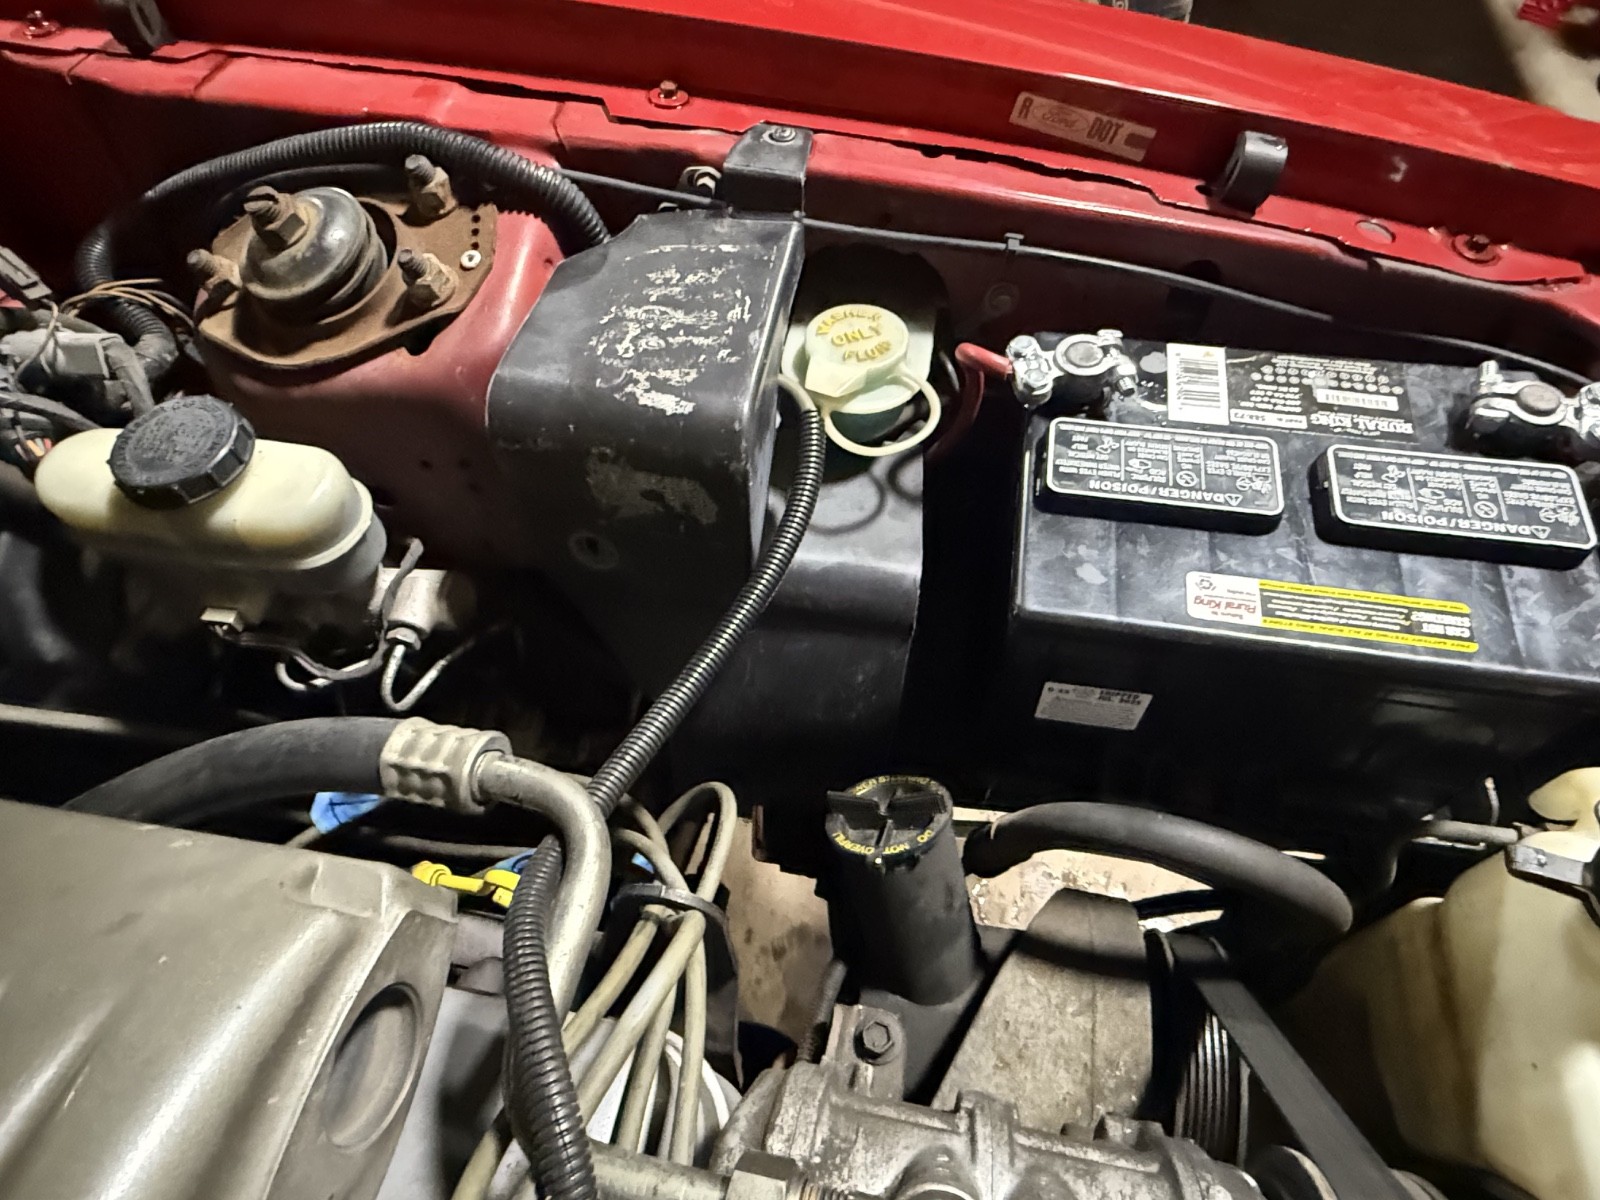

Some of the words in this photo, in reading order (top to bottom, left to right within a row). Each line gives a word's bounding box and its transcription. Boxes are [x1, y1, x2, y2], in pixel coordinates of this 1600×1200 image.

[1018, 95, 1034, 119] R
[1041, 106, 1080, 130] Ford
[1086, 116, 1125, 145] DOT
[831, 327, 882, 348] ONLY
[843, 341, 892, 363] FLUID
[1309, 413, 1352, 427] KING
[1352, 418, 1413, 433] RURAL
[1192, 595, 1222, 609] King
[1224, 601, 1256, 613] Rural
[916, 829, 934, 843] DO
[882, 842, 911, 855] NOT
